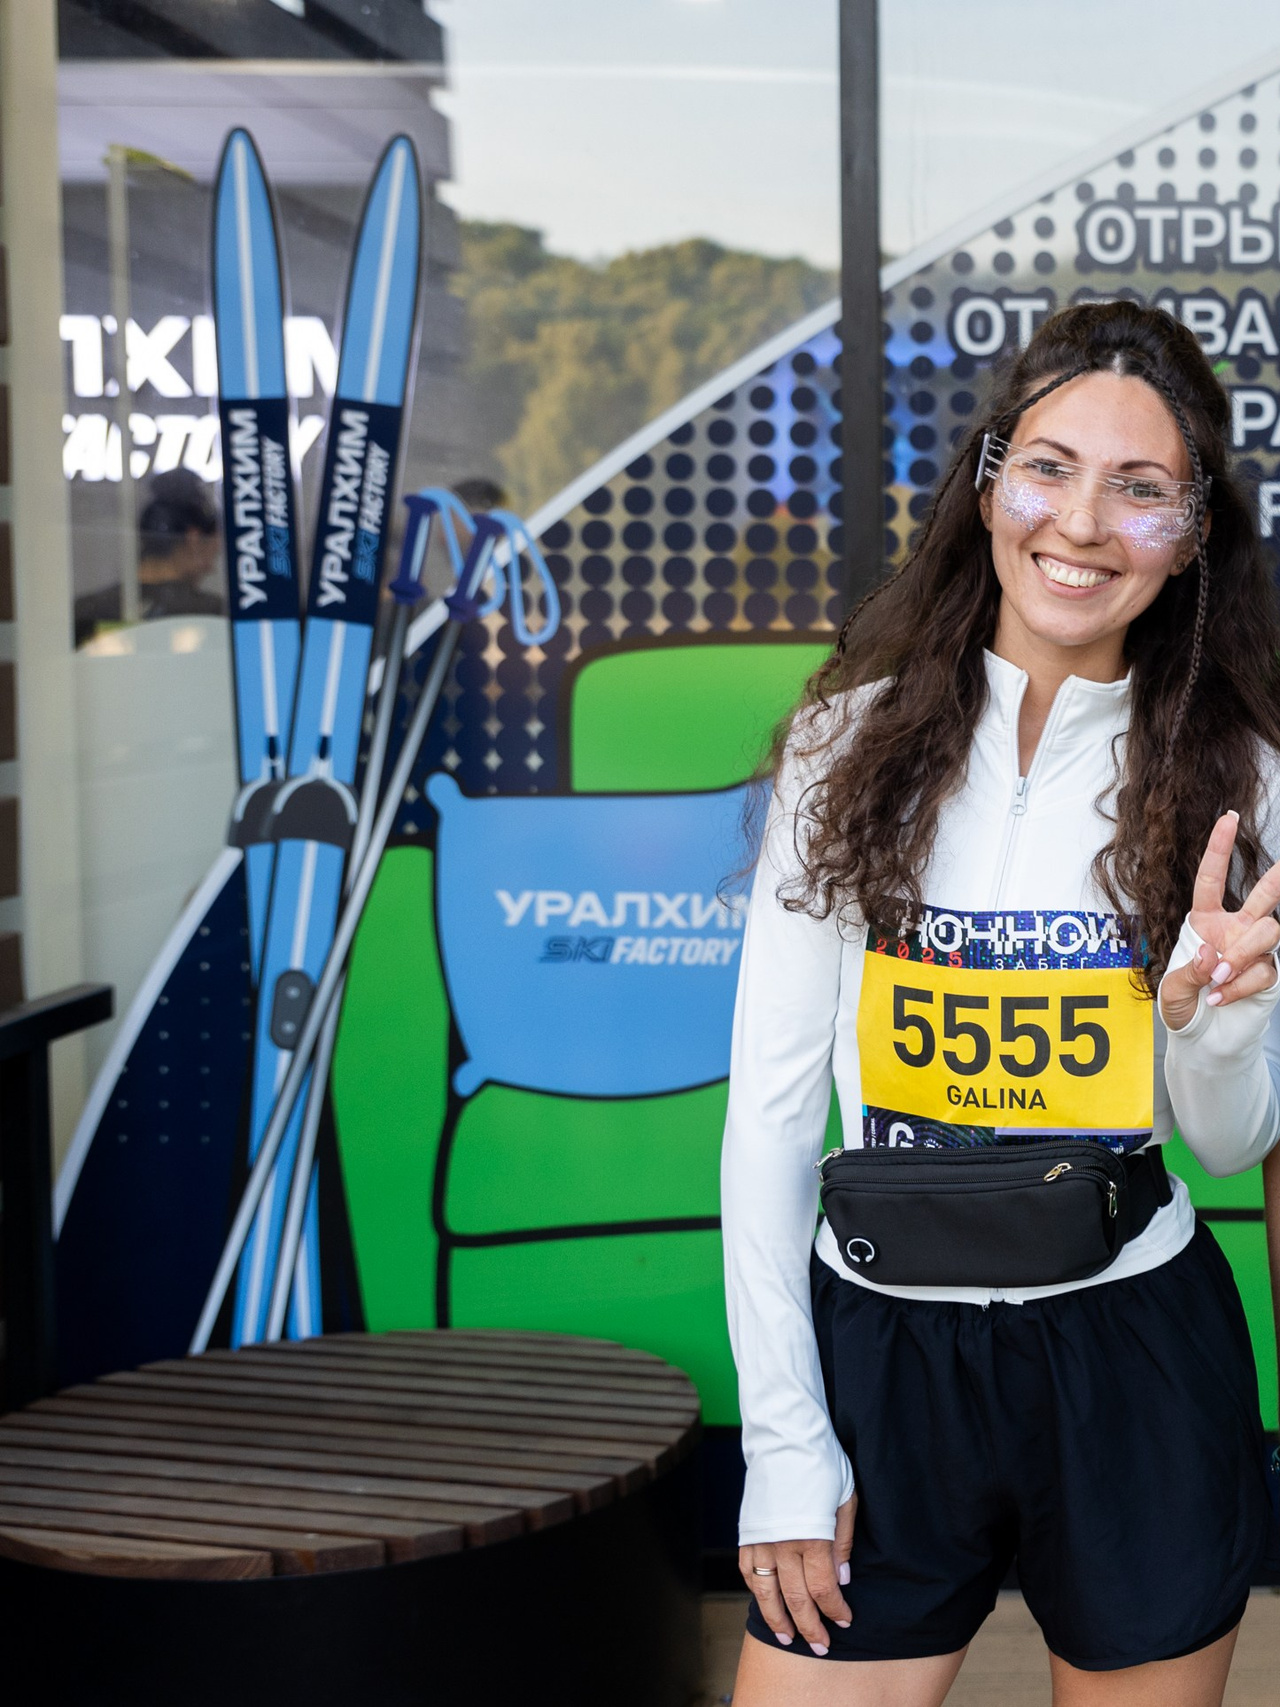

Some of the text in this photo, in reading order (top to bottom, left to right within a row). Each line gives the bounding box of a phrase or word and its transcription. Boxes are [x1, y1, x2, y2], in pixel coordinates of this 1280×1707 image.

[953, 297, 1049, 356] ОТ
[229, 408, 267, 610] УРАЛХИМ
[316, 408, 370, 607] УРАЛХИМ
[876, 938, 963, 968] 2025
[995, 957, 1088, 970] ЗАБЕГ
[893, 984, 1111, 1078] 5555
[946, 1084, 1047, 1110] GALINA
